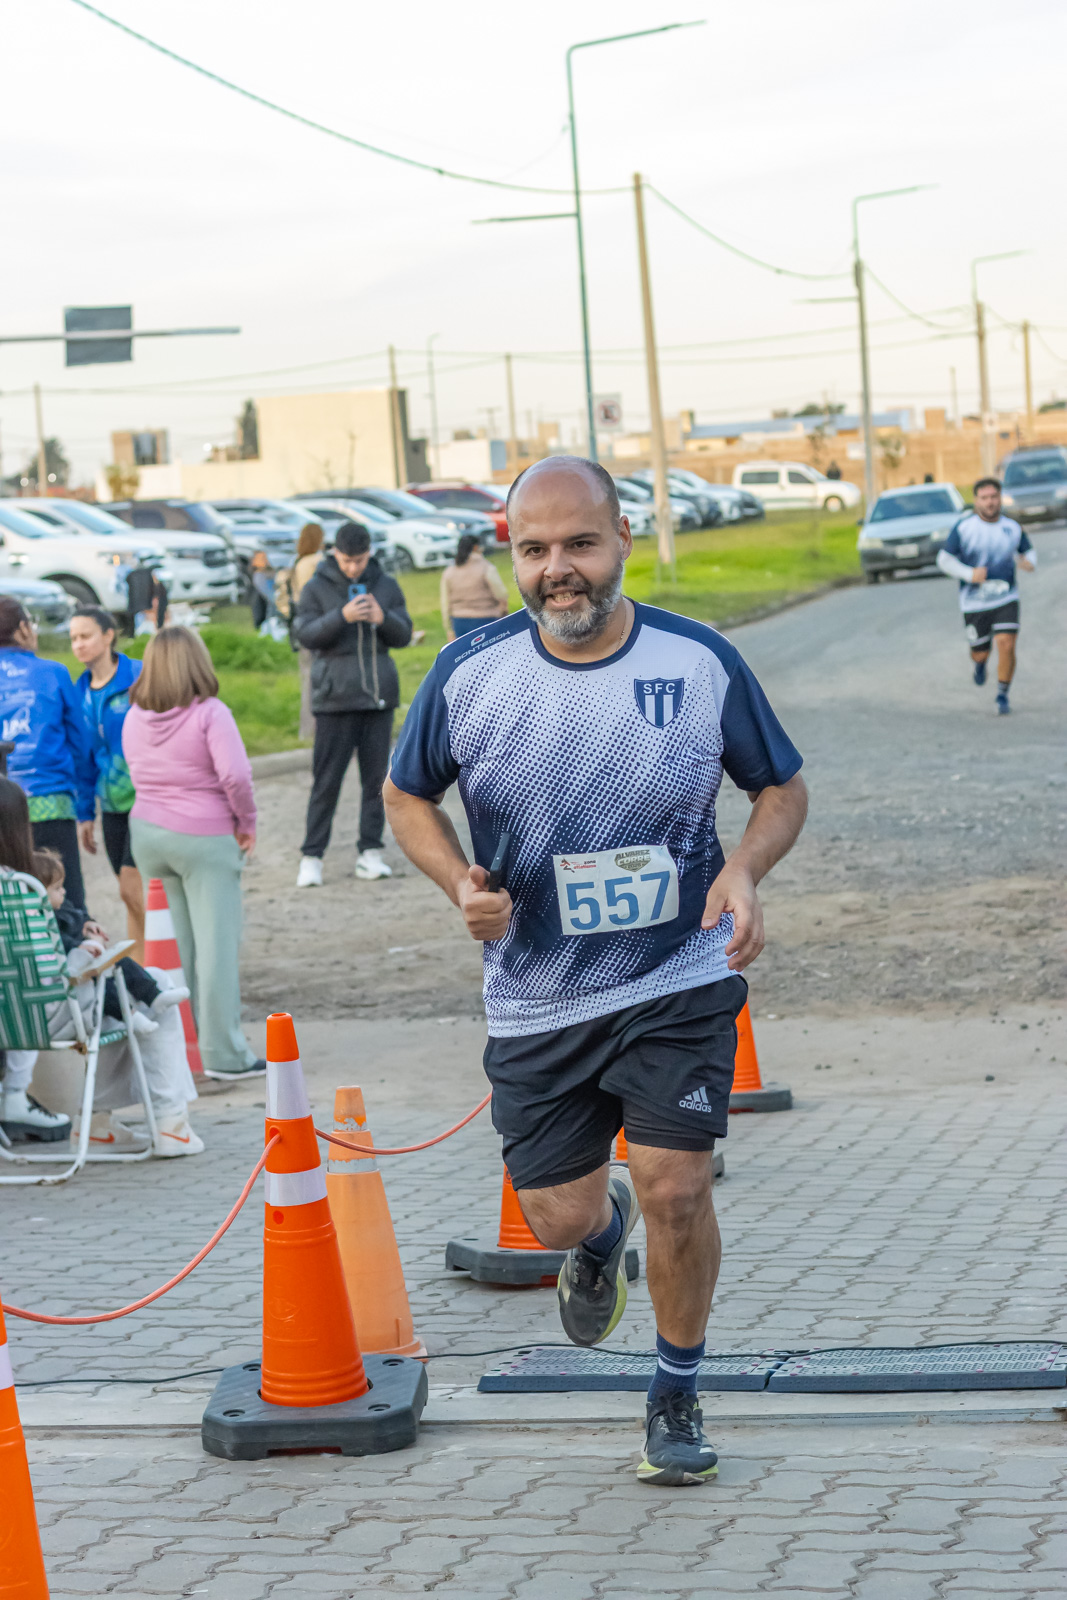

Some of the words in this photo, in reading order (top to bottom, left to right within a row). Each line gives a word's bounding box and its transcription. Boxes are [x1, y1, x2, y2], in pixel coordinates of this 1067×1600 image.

[643, 682, 676, 694] SFC
[614, 849, 651, 860] ALVAREZ
[617, 854, 651, 866] CORRE
[566, 870, 670, 931] 557
[678, 1099, 712, 1113] adidas
